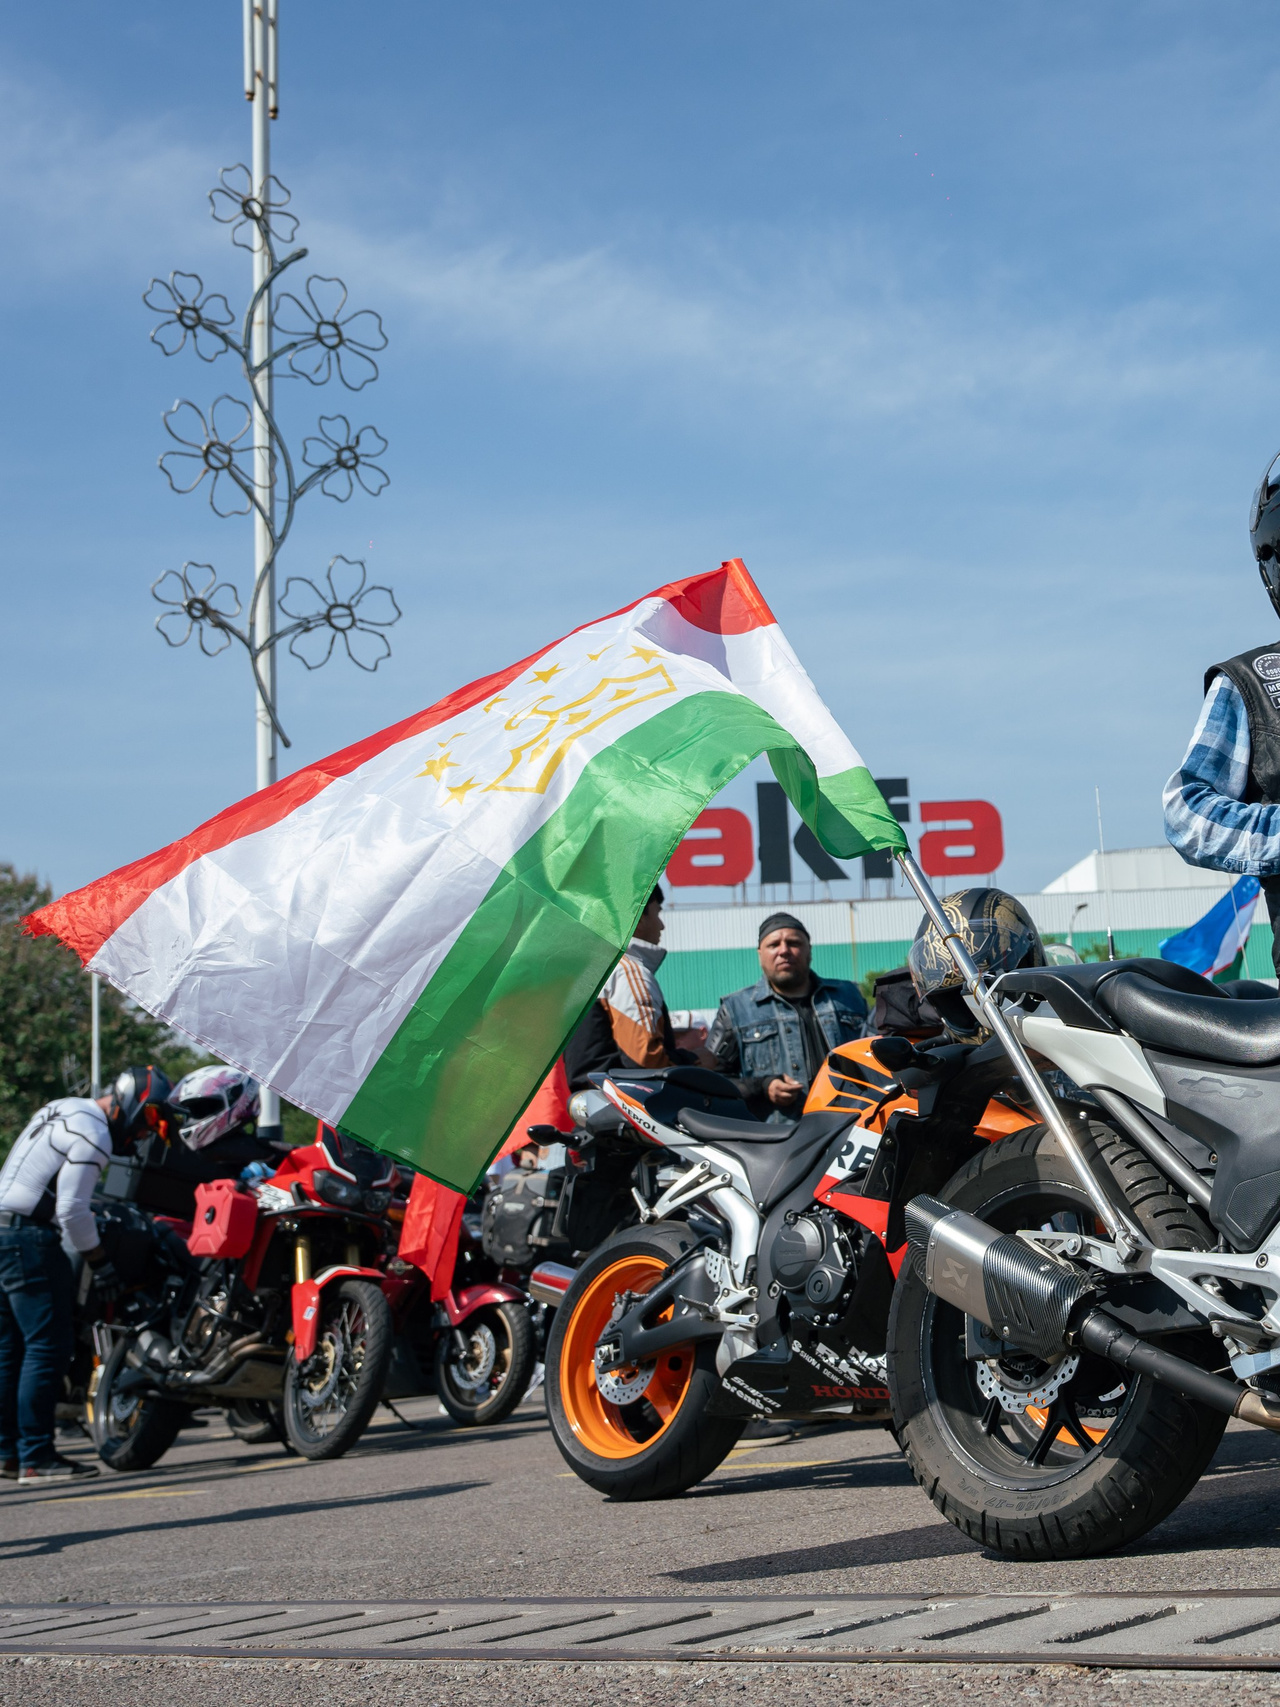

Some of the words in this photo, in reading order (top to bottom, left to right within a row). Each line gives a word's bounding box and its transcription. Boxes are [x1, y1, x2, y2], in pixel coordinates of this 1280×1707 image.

[665, 778, 1004, 887] akfa
[800, 1351, 821, 1370] SHOWA
[822, 1368, 845, 1386] DENKO
[815, 1342, 863, 1382] RK
[722, 1377, 773, 1414] brembo
[811, 1385, 891, 1399] HOND
